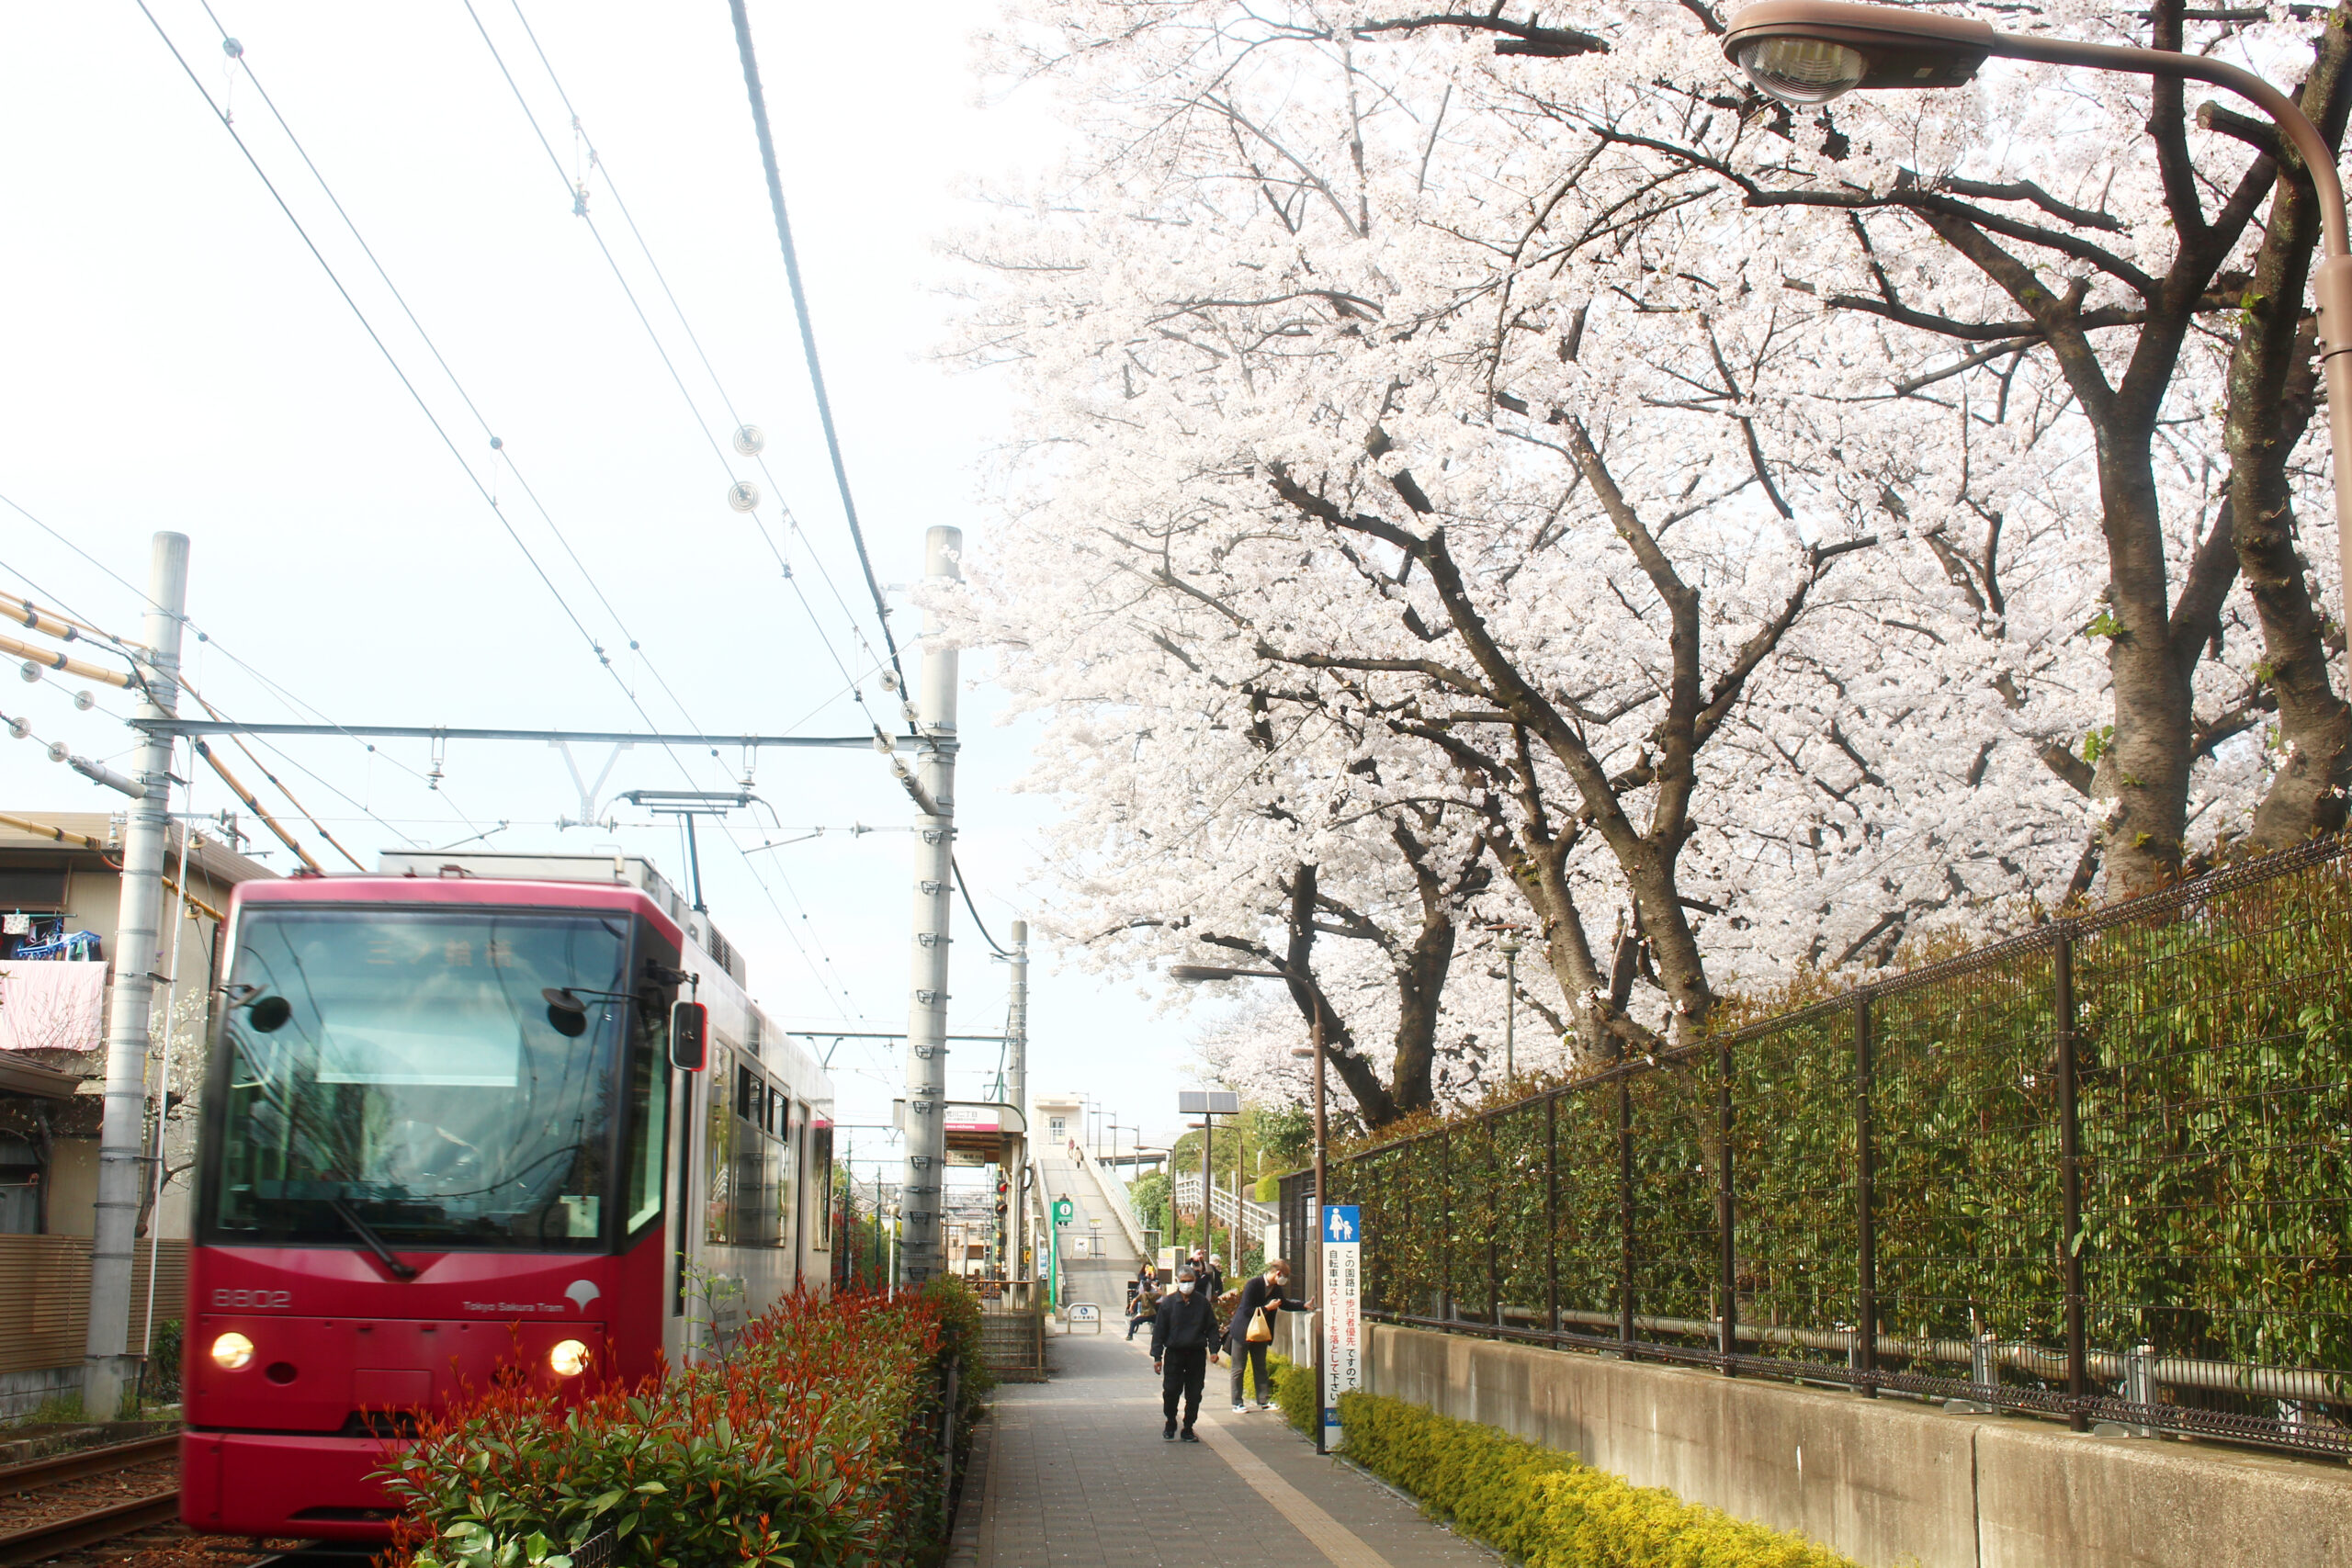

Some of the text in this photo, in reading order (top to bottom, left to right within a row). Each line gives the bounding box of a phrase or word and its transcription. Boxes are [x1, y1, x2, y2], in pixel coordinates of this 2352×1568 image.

[368, 939, 512, 967] 三ノ輪橋
[212, 1289, 291, 1308] 8802
[462, 1301, 565, 1313] Tokyo Sakura Tram
[1329, 1250, 1340, 1401] 自転車はスピードを落として下さい
